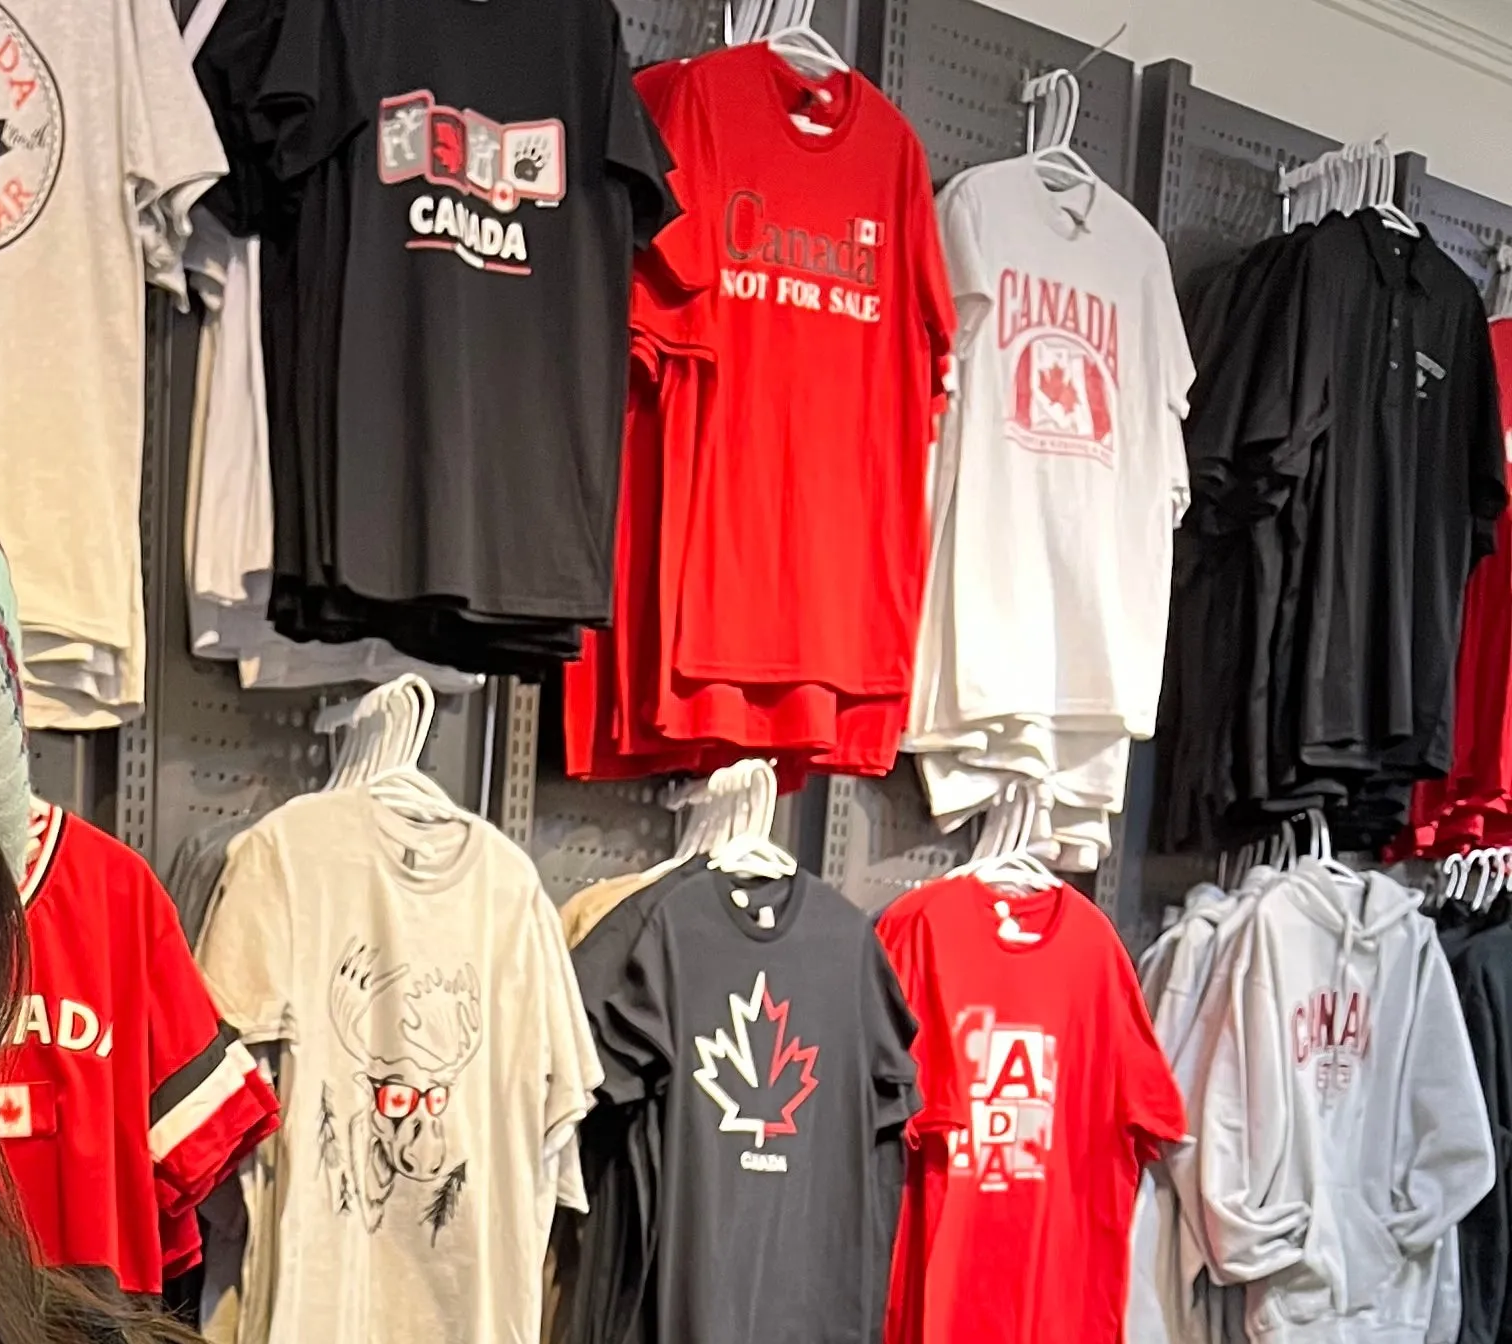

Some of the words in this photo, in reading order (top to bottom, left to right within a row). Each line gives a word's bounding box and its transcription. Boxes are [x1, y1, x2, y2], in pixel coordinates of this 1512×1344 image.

[726, 189, 876, 286] Canada
[720, 269, 769, 300] NOT
[776, 276, 821, 310] FOR
[998, 268, 1120, 388] CANADA
